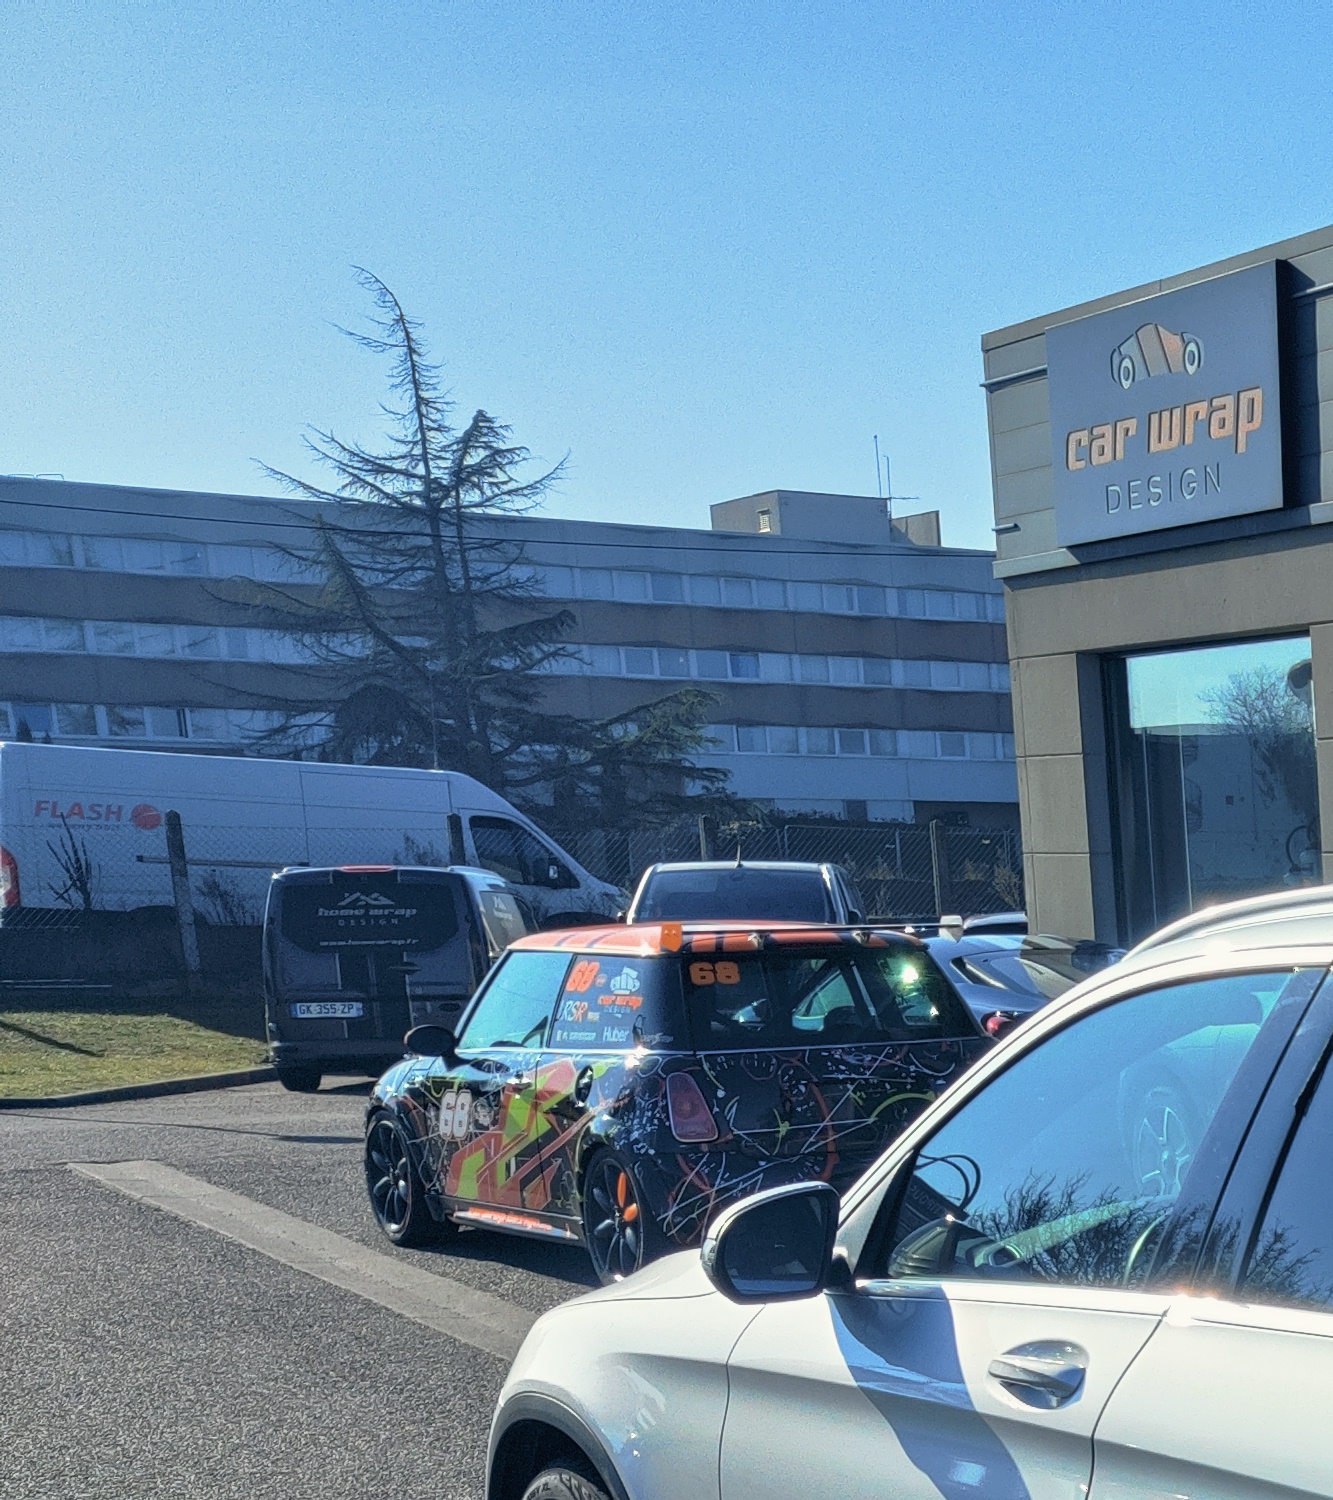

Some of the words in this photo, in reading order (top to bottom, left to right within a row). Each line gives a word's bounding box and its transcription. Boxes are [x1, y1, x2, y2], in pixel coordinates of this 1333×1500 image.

[1066, 416, 1137, 472] car
[1148, 386, 1263, 454] wrap
[1106, 462, 1222, 514] DESIGN
[34, 799, 123, 822] FLASH
[689, 961, 741, 986] 68
